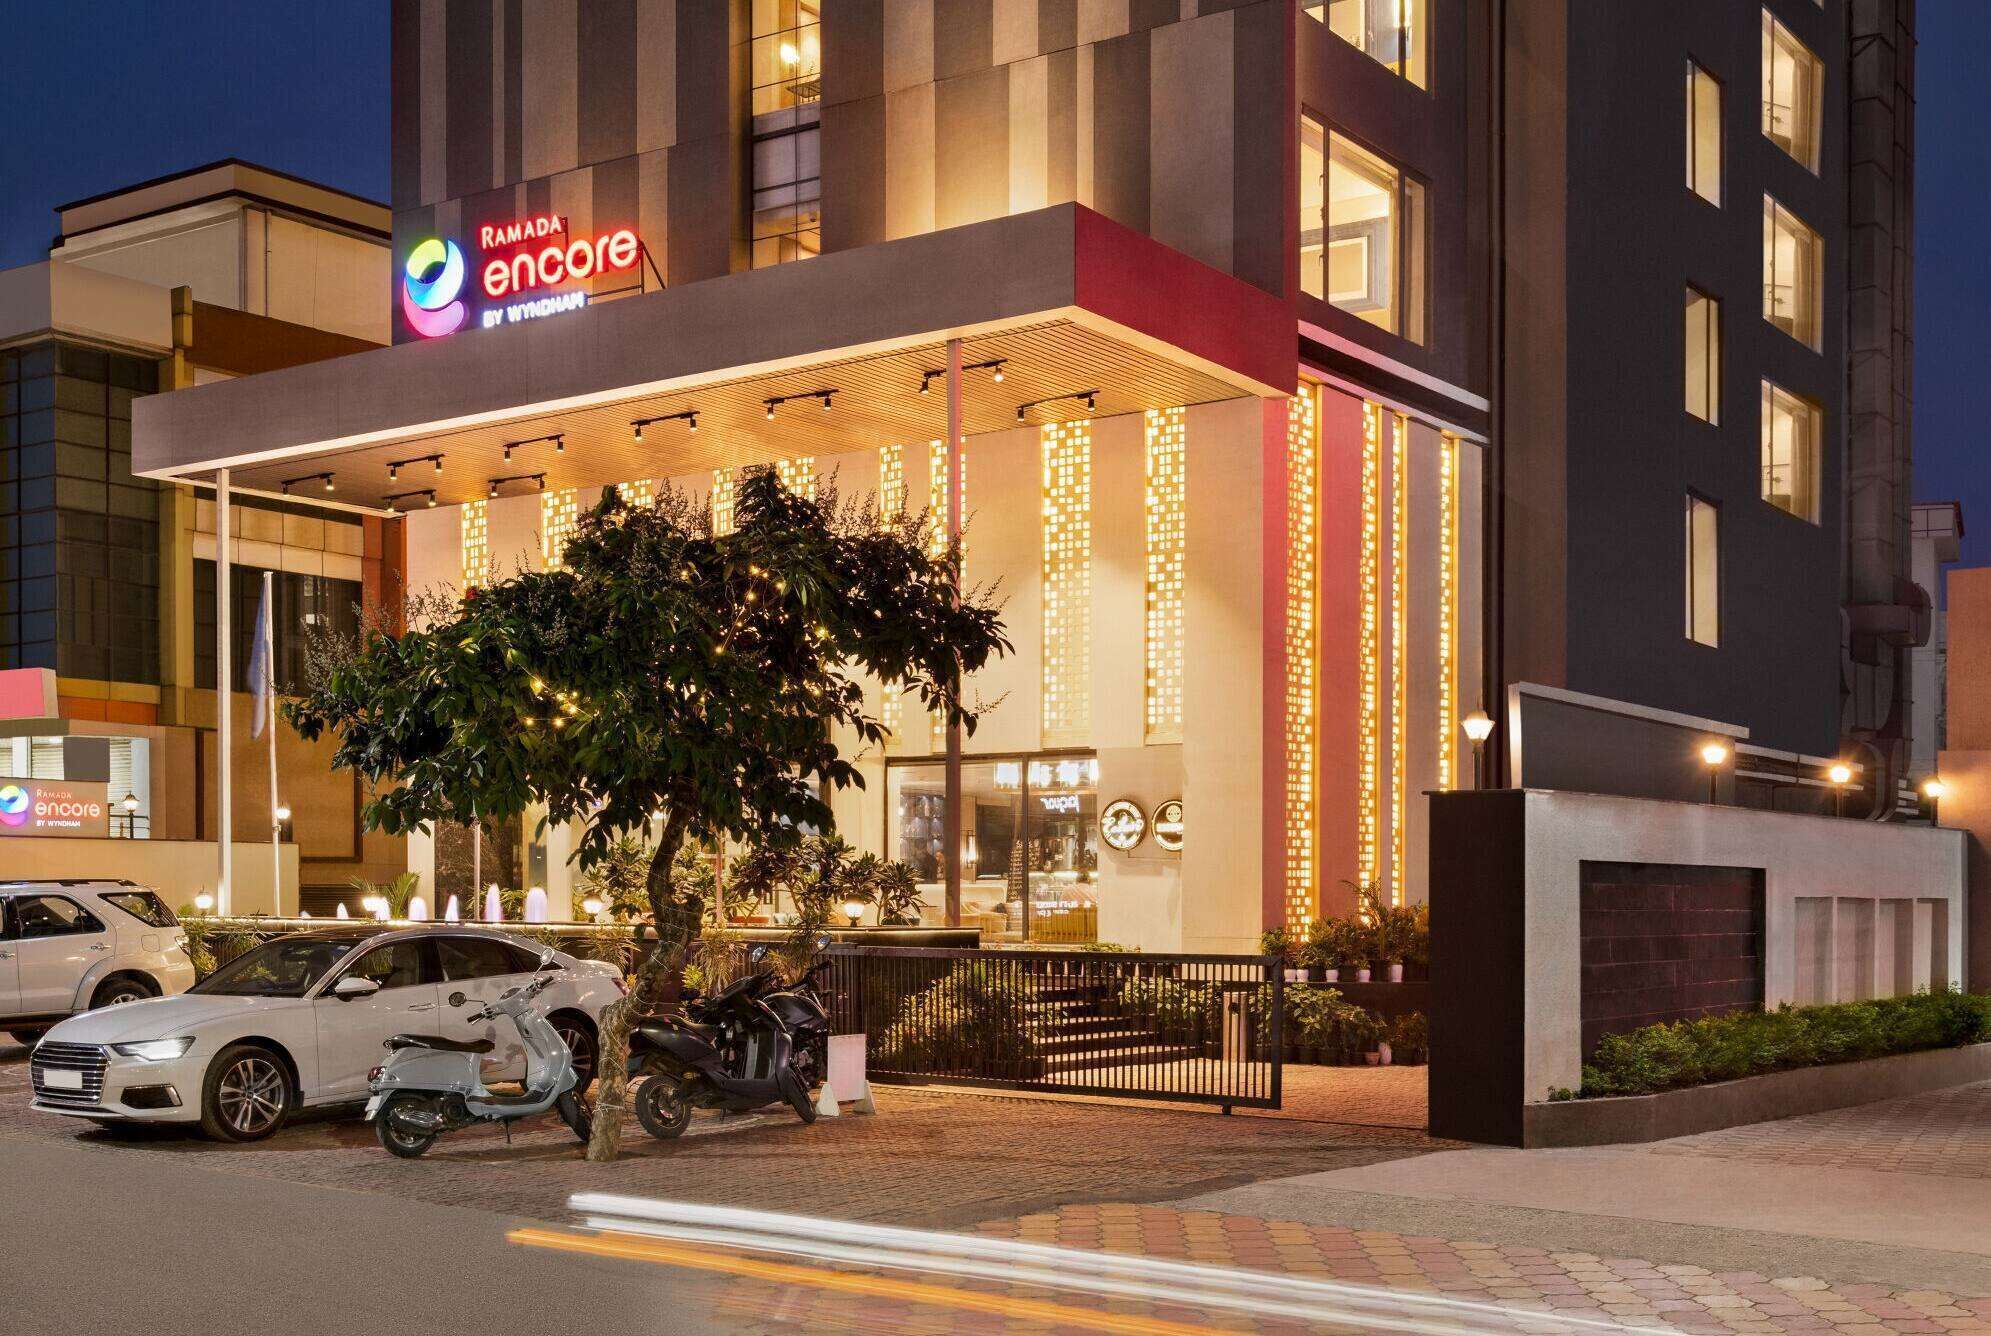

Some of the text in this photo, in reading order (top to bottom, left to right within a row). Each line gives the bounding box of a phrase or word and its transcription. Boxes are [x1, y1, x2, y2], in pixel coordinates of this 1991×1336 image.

[481, 214, 562, 250] RAMADA
[483, 229, 639, 297] encore
[483, 290, 585, 329] BY WYNDHAM
[36, 788, 73, 799] RAMADA
[34, 801, 101, 817] encore
[36, 819, 81, 828] BY WYNDHAM
